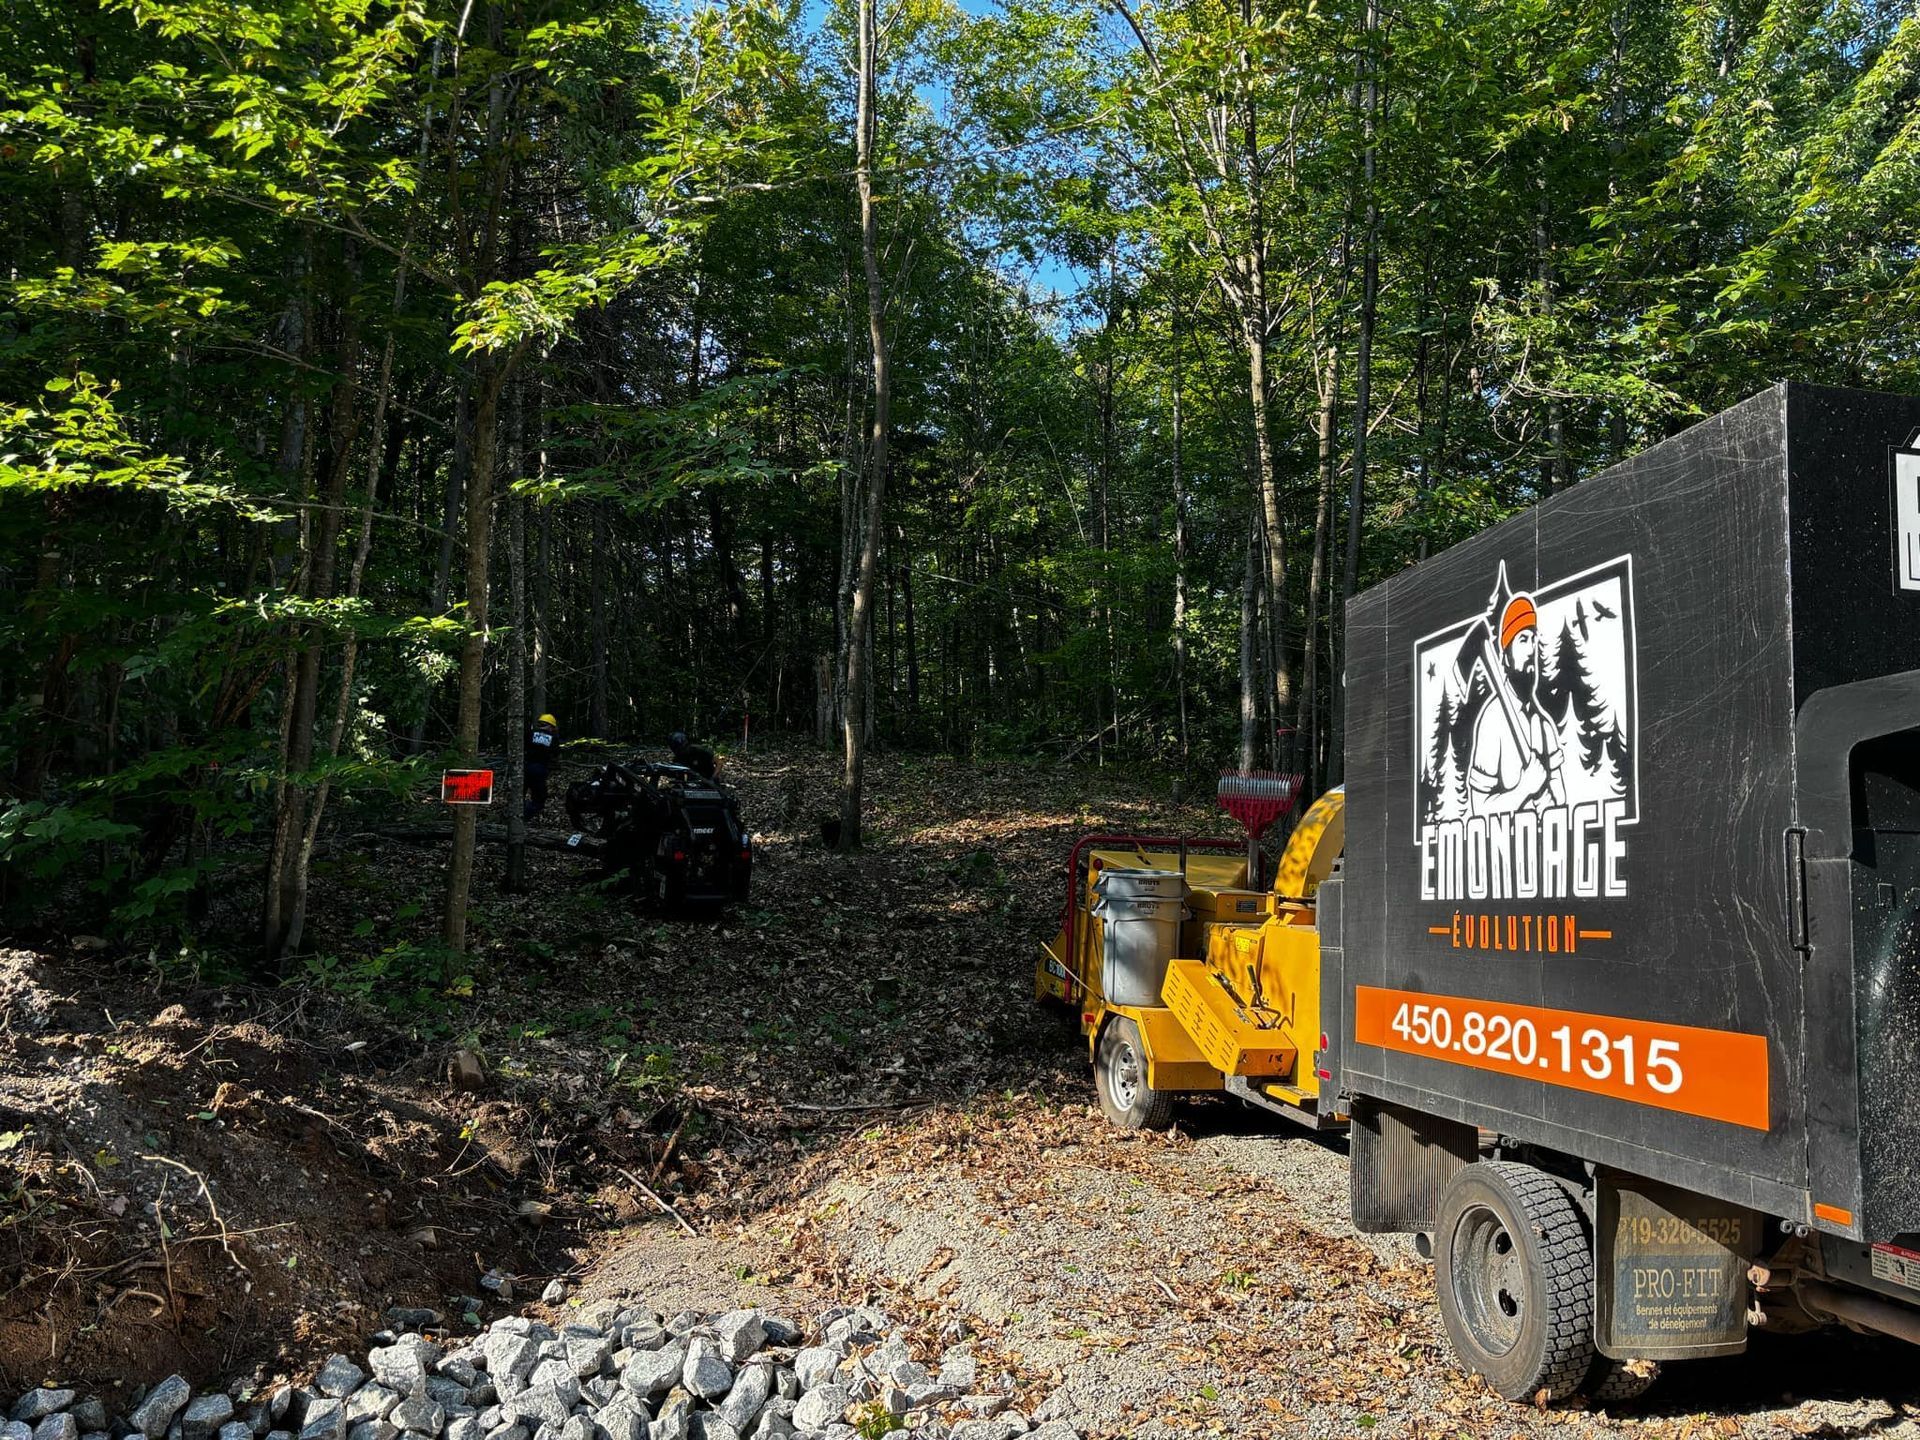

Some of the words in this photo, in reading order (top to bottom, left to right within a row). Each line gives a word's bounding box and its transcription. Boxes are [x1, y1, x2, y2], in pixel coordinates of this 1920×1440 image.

[1453, 910, 1576, 953] ÉVOLUTION
[1391, 1002, 1684, 1094] 450.820.1315
[1633, 1268, 1722, 1298] PRO-FIT
[1636, 1304, 1663, 1316] Bennes
[1664, 1304, 1672, 1315] et
[1672, 1302, 1718, 1317] équipements
[1648, 1318, 1659, 1329] de
